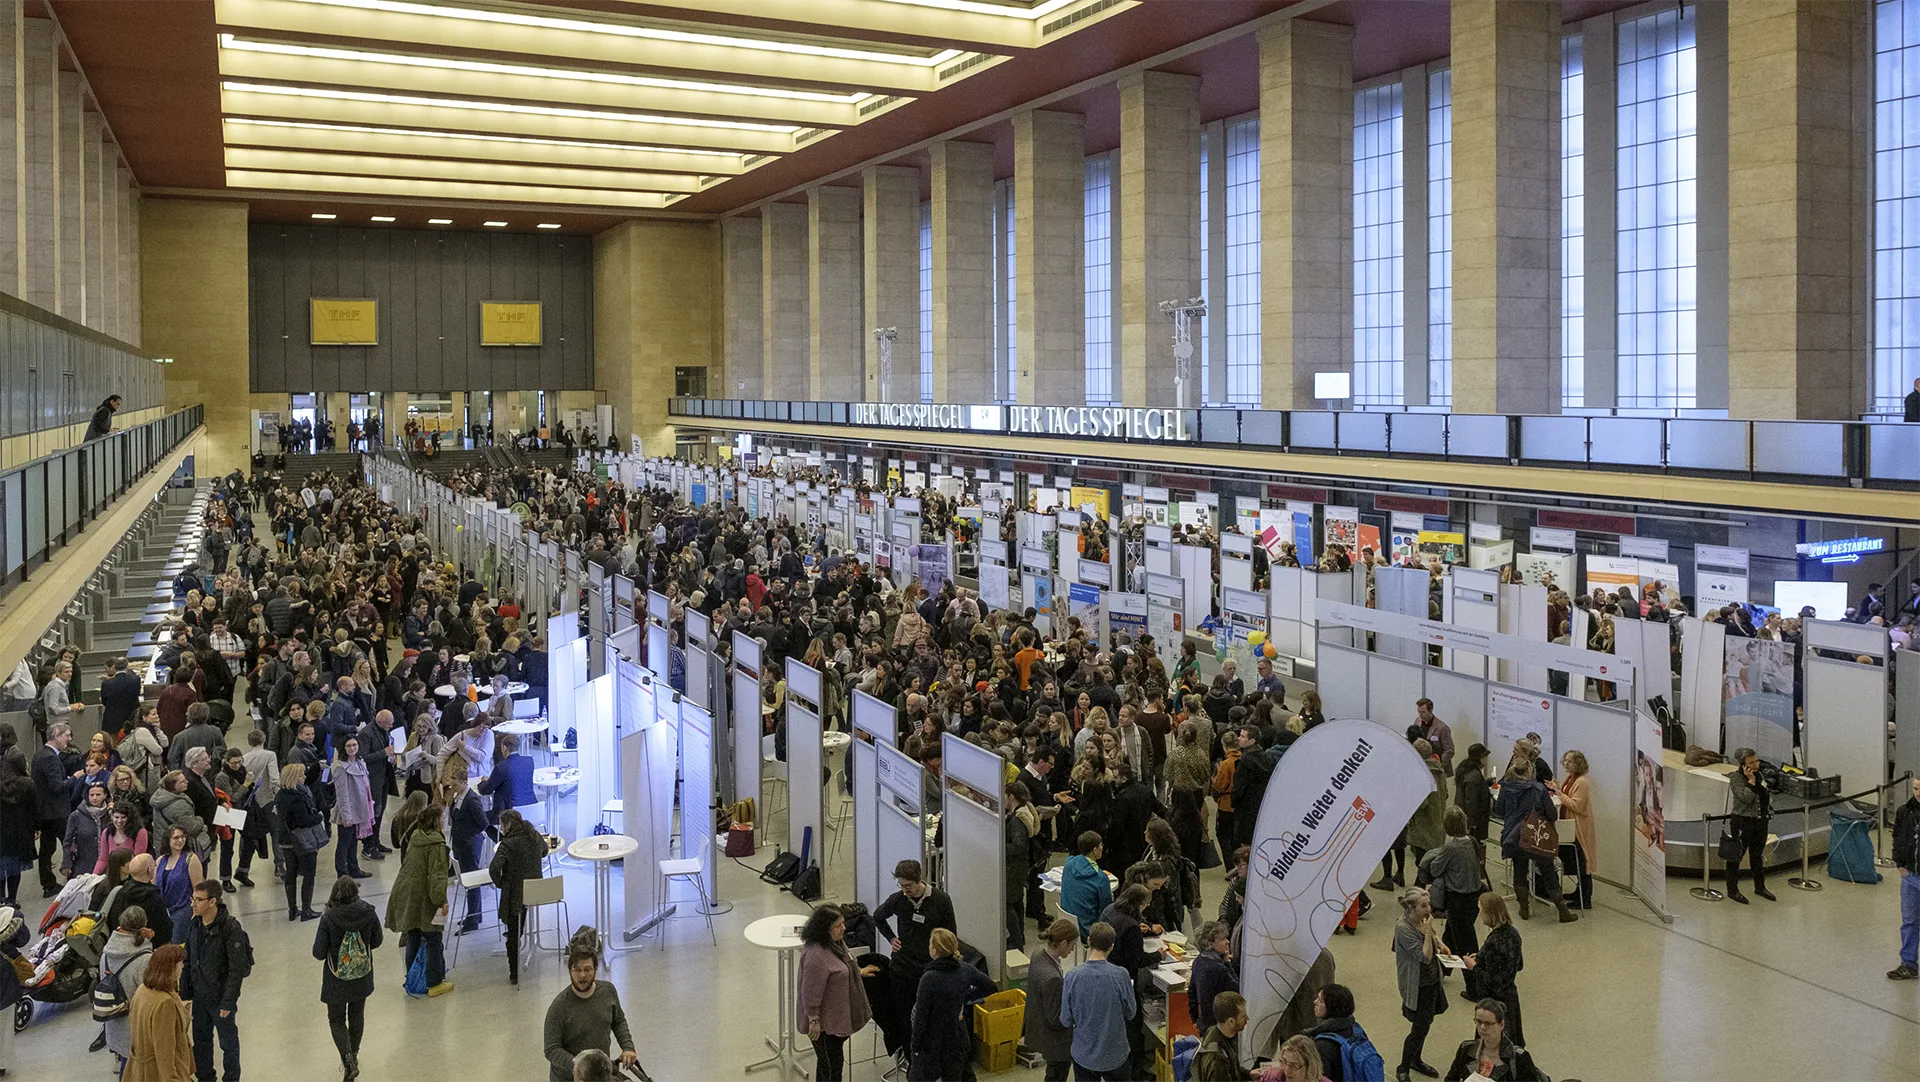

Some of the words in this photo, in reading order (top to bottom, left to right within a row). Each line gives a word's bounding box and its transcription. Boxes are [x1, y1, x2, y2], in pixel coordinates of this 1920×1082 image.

[856, 403, 877, 424] DER
[879, 403, 965, 429] TAGESSPIEGEL
[1010, 406, 1041, 433] DER
[1046, 407, 1187, 440] TAGESSPIEGEL
[1809, 545, 1829, 557] ZUM
[1831, 539, 1883, 554] RESTAURANT
[1270, 832, 1311, 881] Bildung.
[1301, 788, 1337, 830] Weiter
[1331, 737, 1373, 791] denken!
[1354, 802, 1372, 821] GEW
